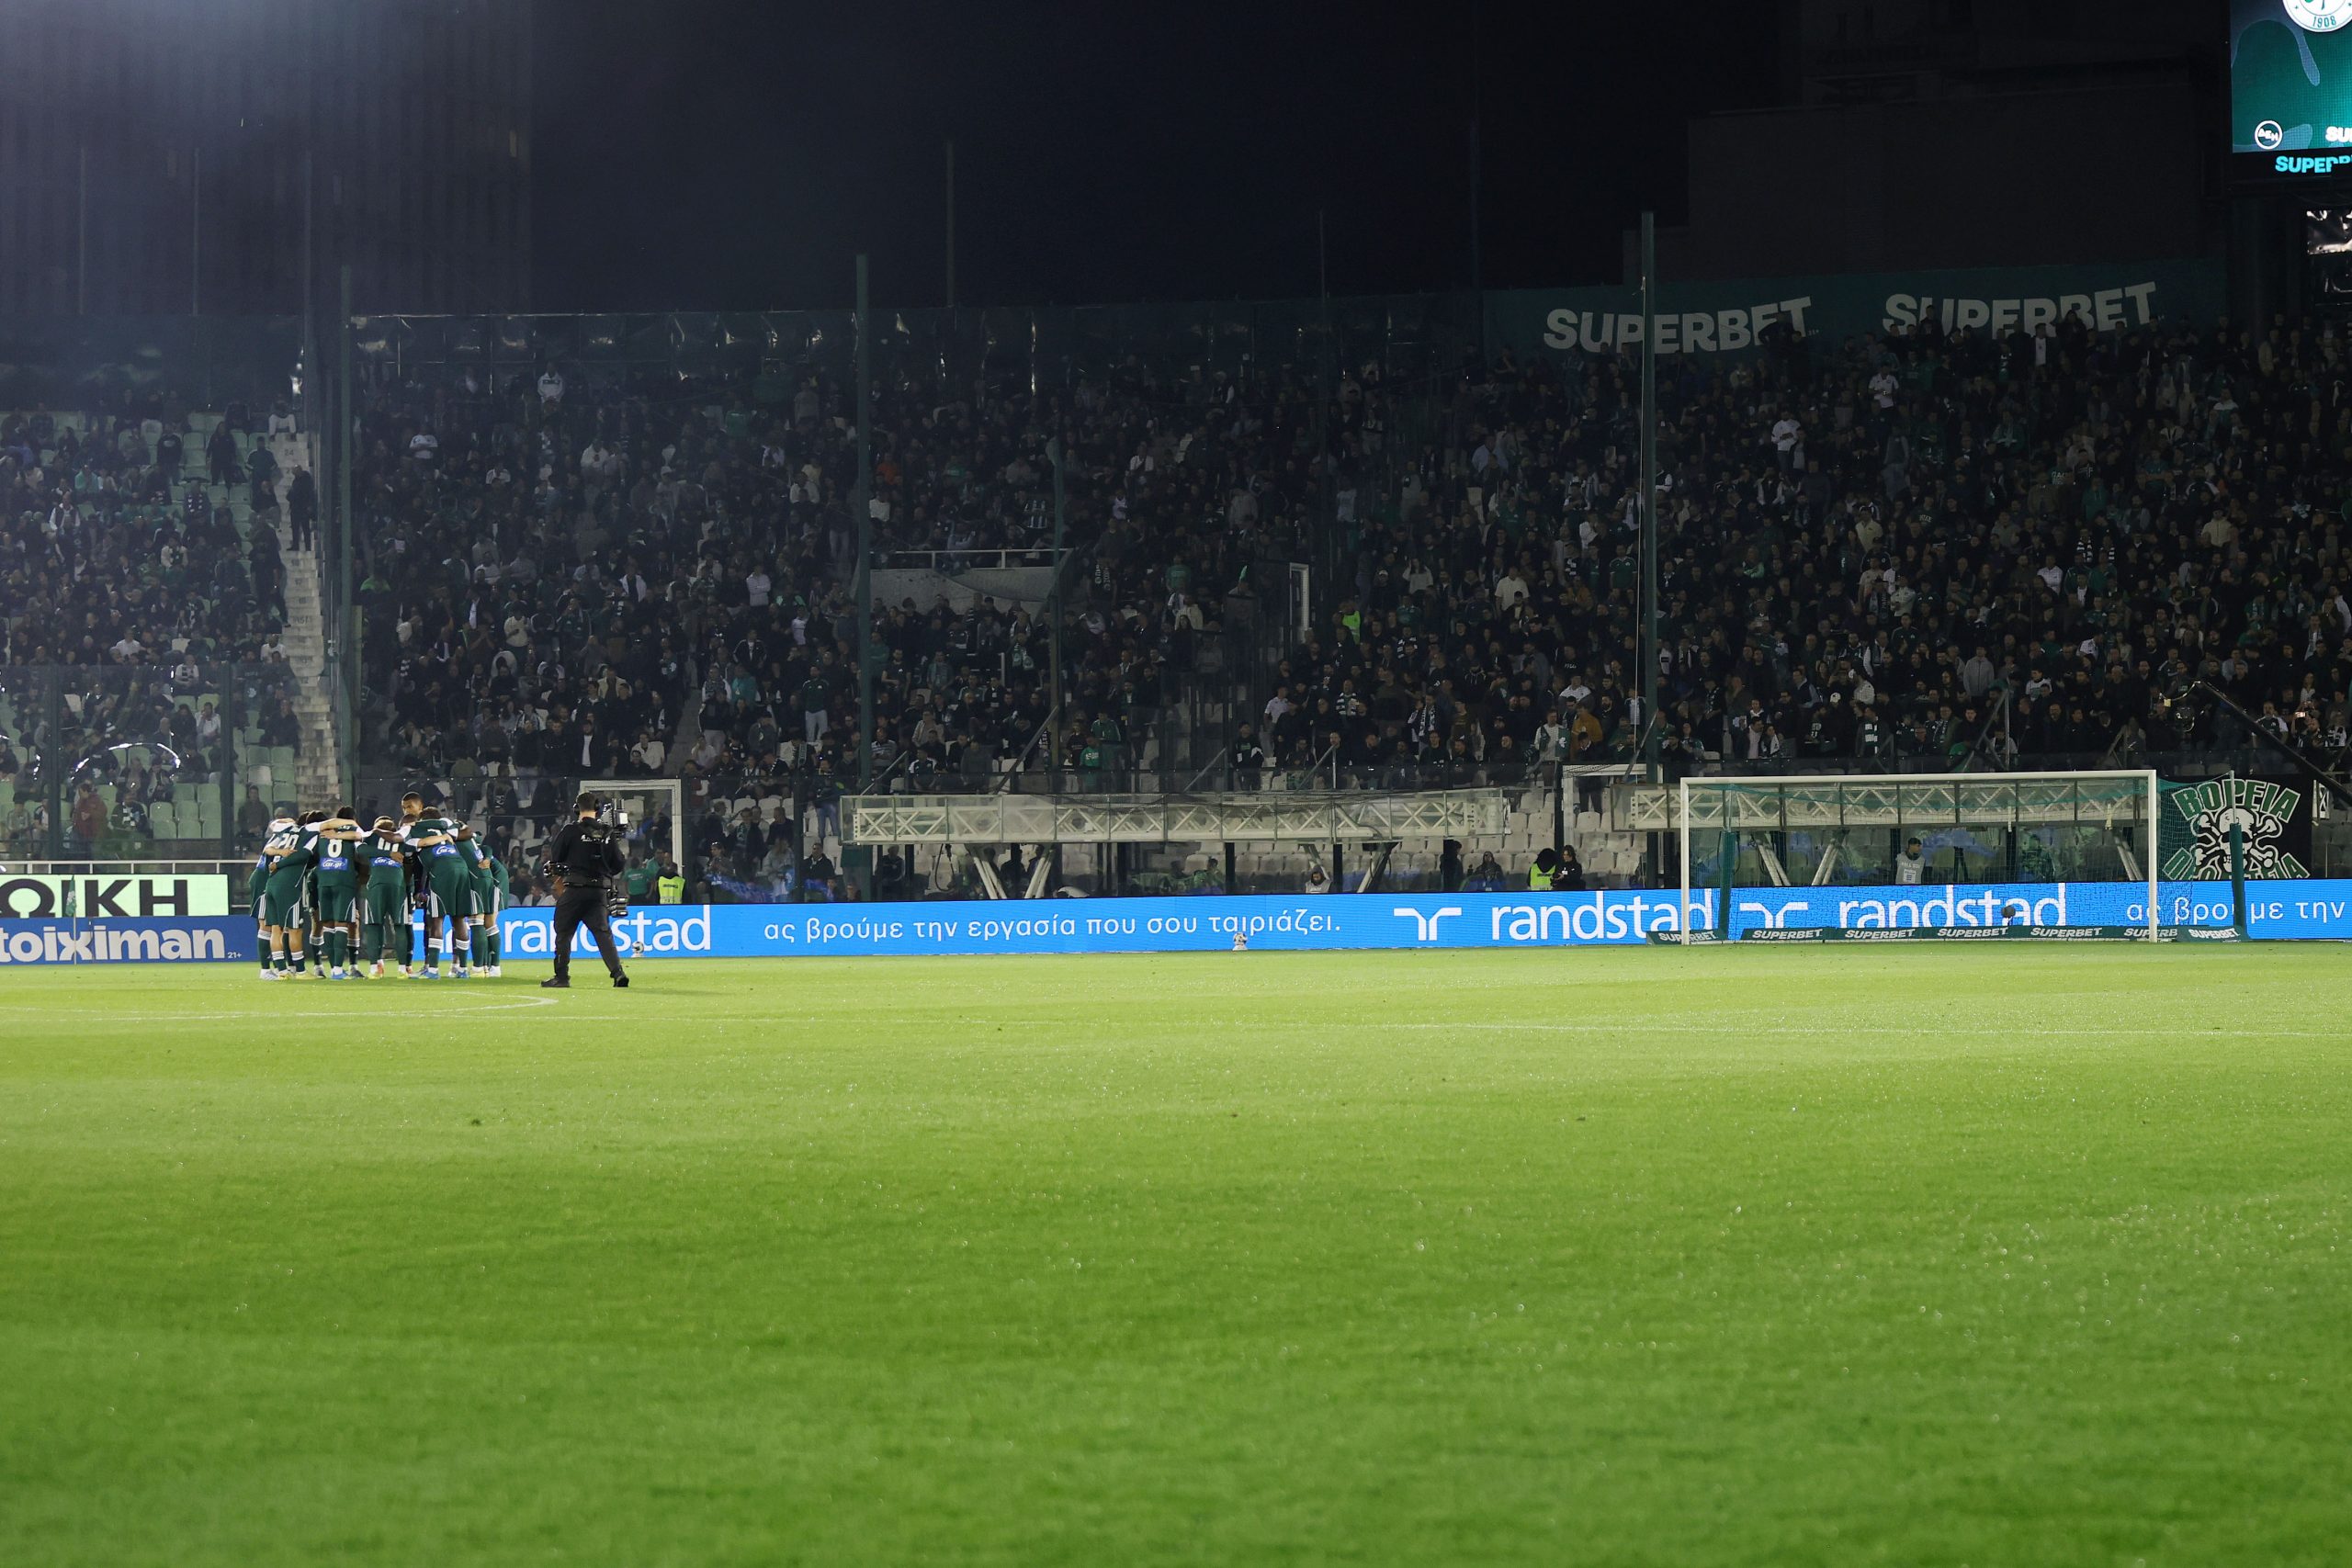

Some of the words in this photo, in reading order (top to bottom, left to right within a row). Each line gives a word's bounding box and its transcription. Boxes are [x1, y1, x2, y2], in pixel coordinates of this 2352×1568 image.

[2312, 15, 2337, 28] 1908
[2324, 125, 2352, 142] SU
[1543, 295, 1812, 355] SUPERBET
[1838, 882, 2066, 928] randstad
[2174, 896, 2284, 926] βρομε
[2295, 900, 2346, 924] την
[1491, 889, 1713, 940] randstad
[763, 922, 796, 943] ας
[806, 916, 904, 944] βρούμε
[912, 920, 958, 942] την
[967, 913, 1075, 942] εργασία
[1085, 917, 1136, 936] που
[1147, 915, 1197, 935] σου
[1207, 908, 1341, 937] ταιριάζει.
[1937, 926, 2008, 938] SUPERBET
[2030, 927, 2103, 938] SUPERBET
[1657, 930, 1717, 942] SUPRBET
[1751, 929, 1824, 940] SUPERBET
[1844, 928, 1917, 940] SUPERBET
[2188, 927, 2241, 939] SUPERBET
